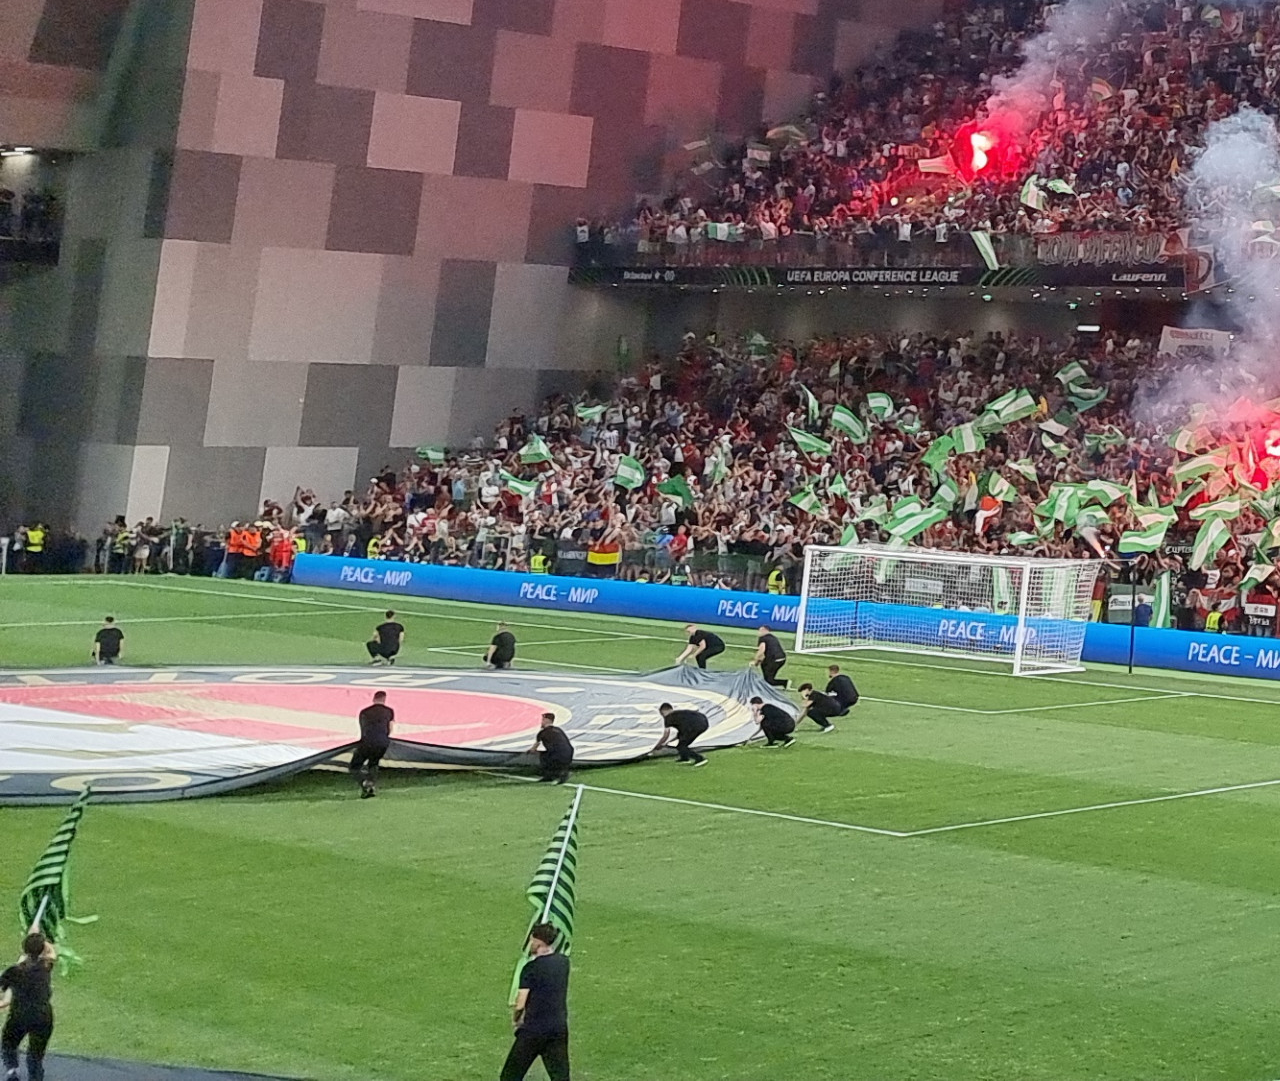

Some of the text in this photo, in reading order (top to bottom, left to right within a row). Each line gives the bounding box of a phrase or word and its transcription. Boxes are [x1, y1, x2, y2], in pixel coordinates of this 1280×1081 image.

[787, 270, 959, 282] UEFA EUROPA CONFERENCE LEAGUE
[341, 566, 375, 584] PEACE
[520, 582, 557, 601] PEACE
[718, 600, 760, 619] PEACE
[938, 619, 986, 640] PEACE
[1188, 642, 1240, 665] PEACE
